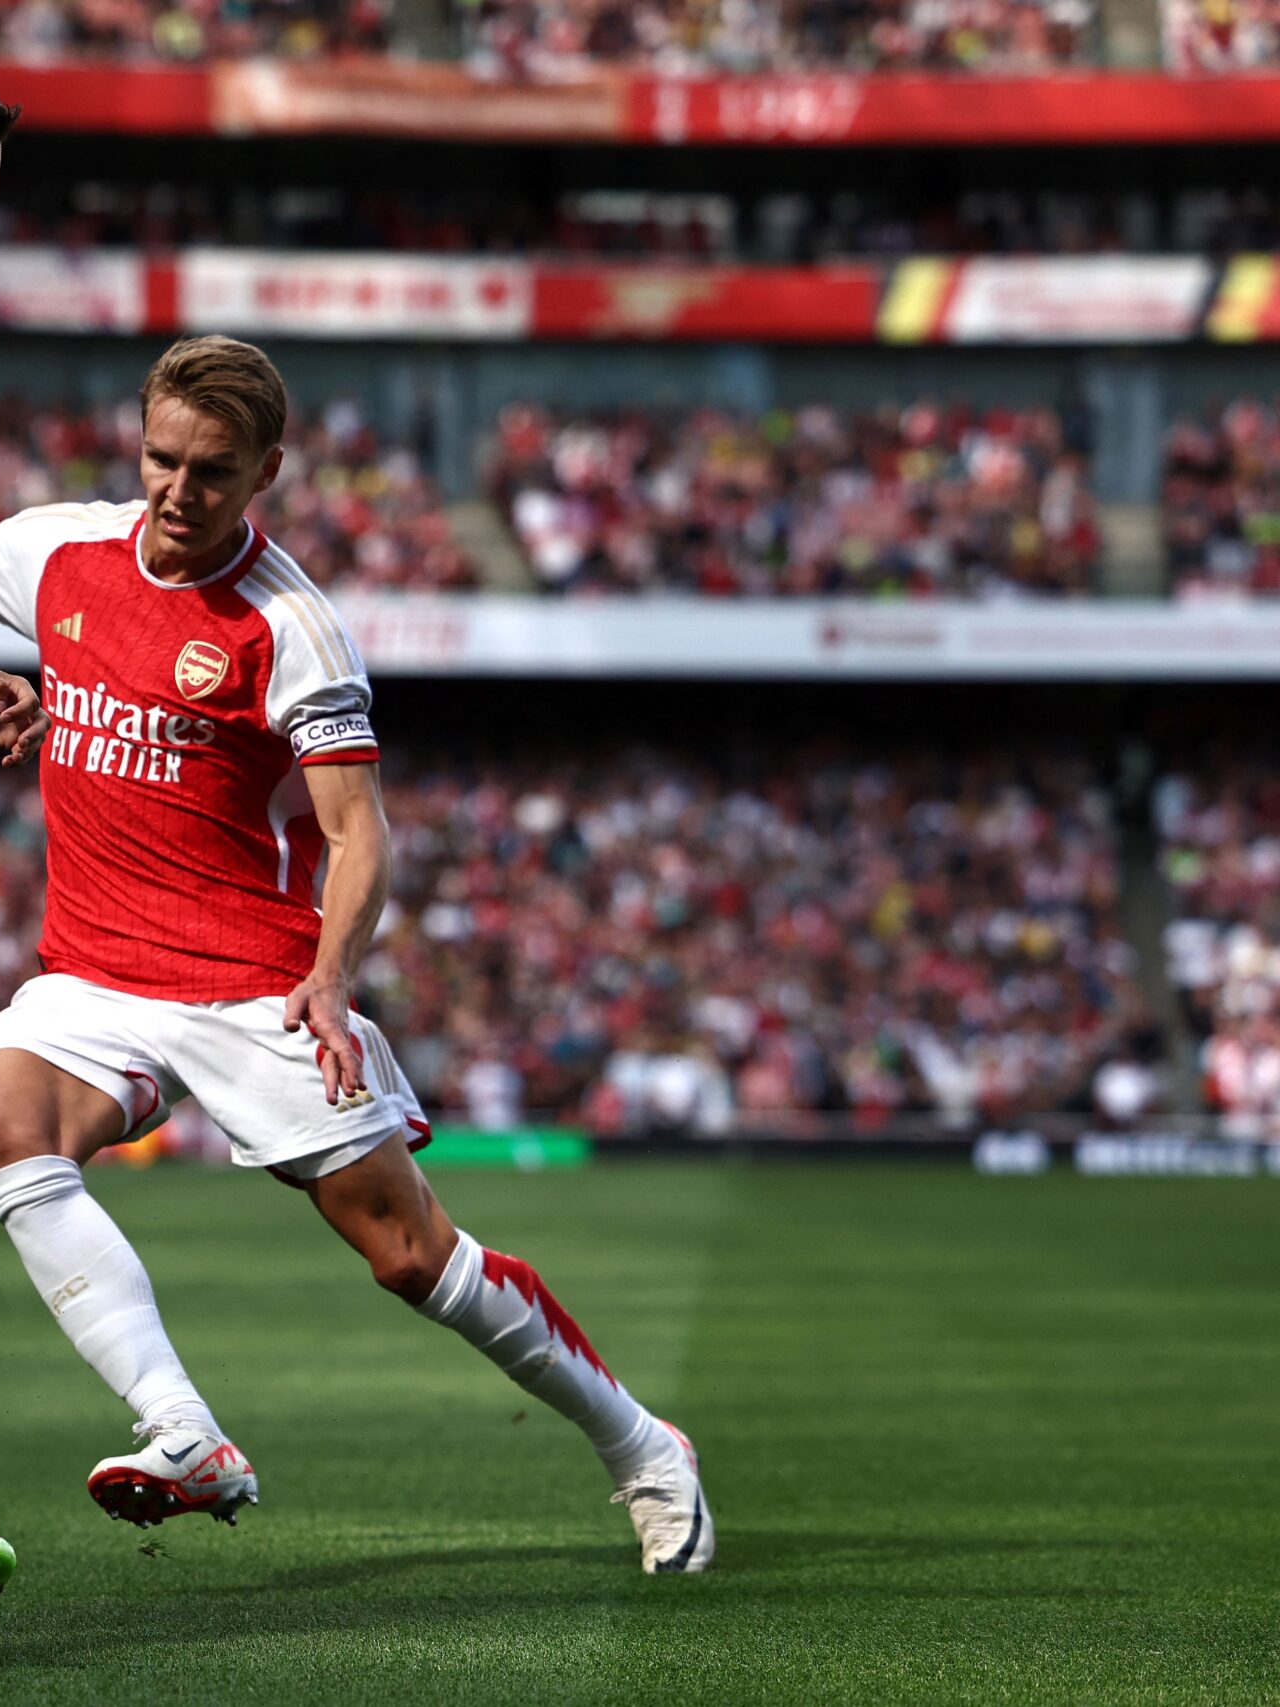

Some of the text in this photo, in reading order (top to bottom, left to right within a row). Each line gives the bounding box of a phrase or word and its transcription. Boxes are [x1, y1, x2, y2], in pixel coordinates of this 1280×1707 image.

[187, 649, 223, 669] Arsenal
[43, 664, 215, 746] Emirates
[50, 725, 182, 784] FLY BETTER
